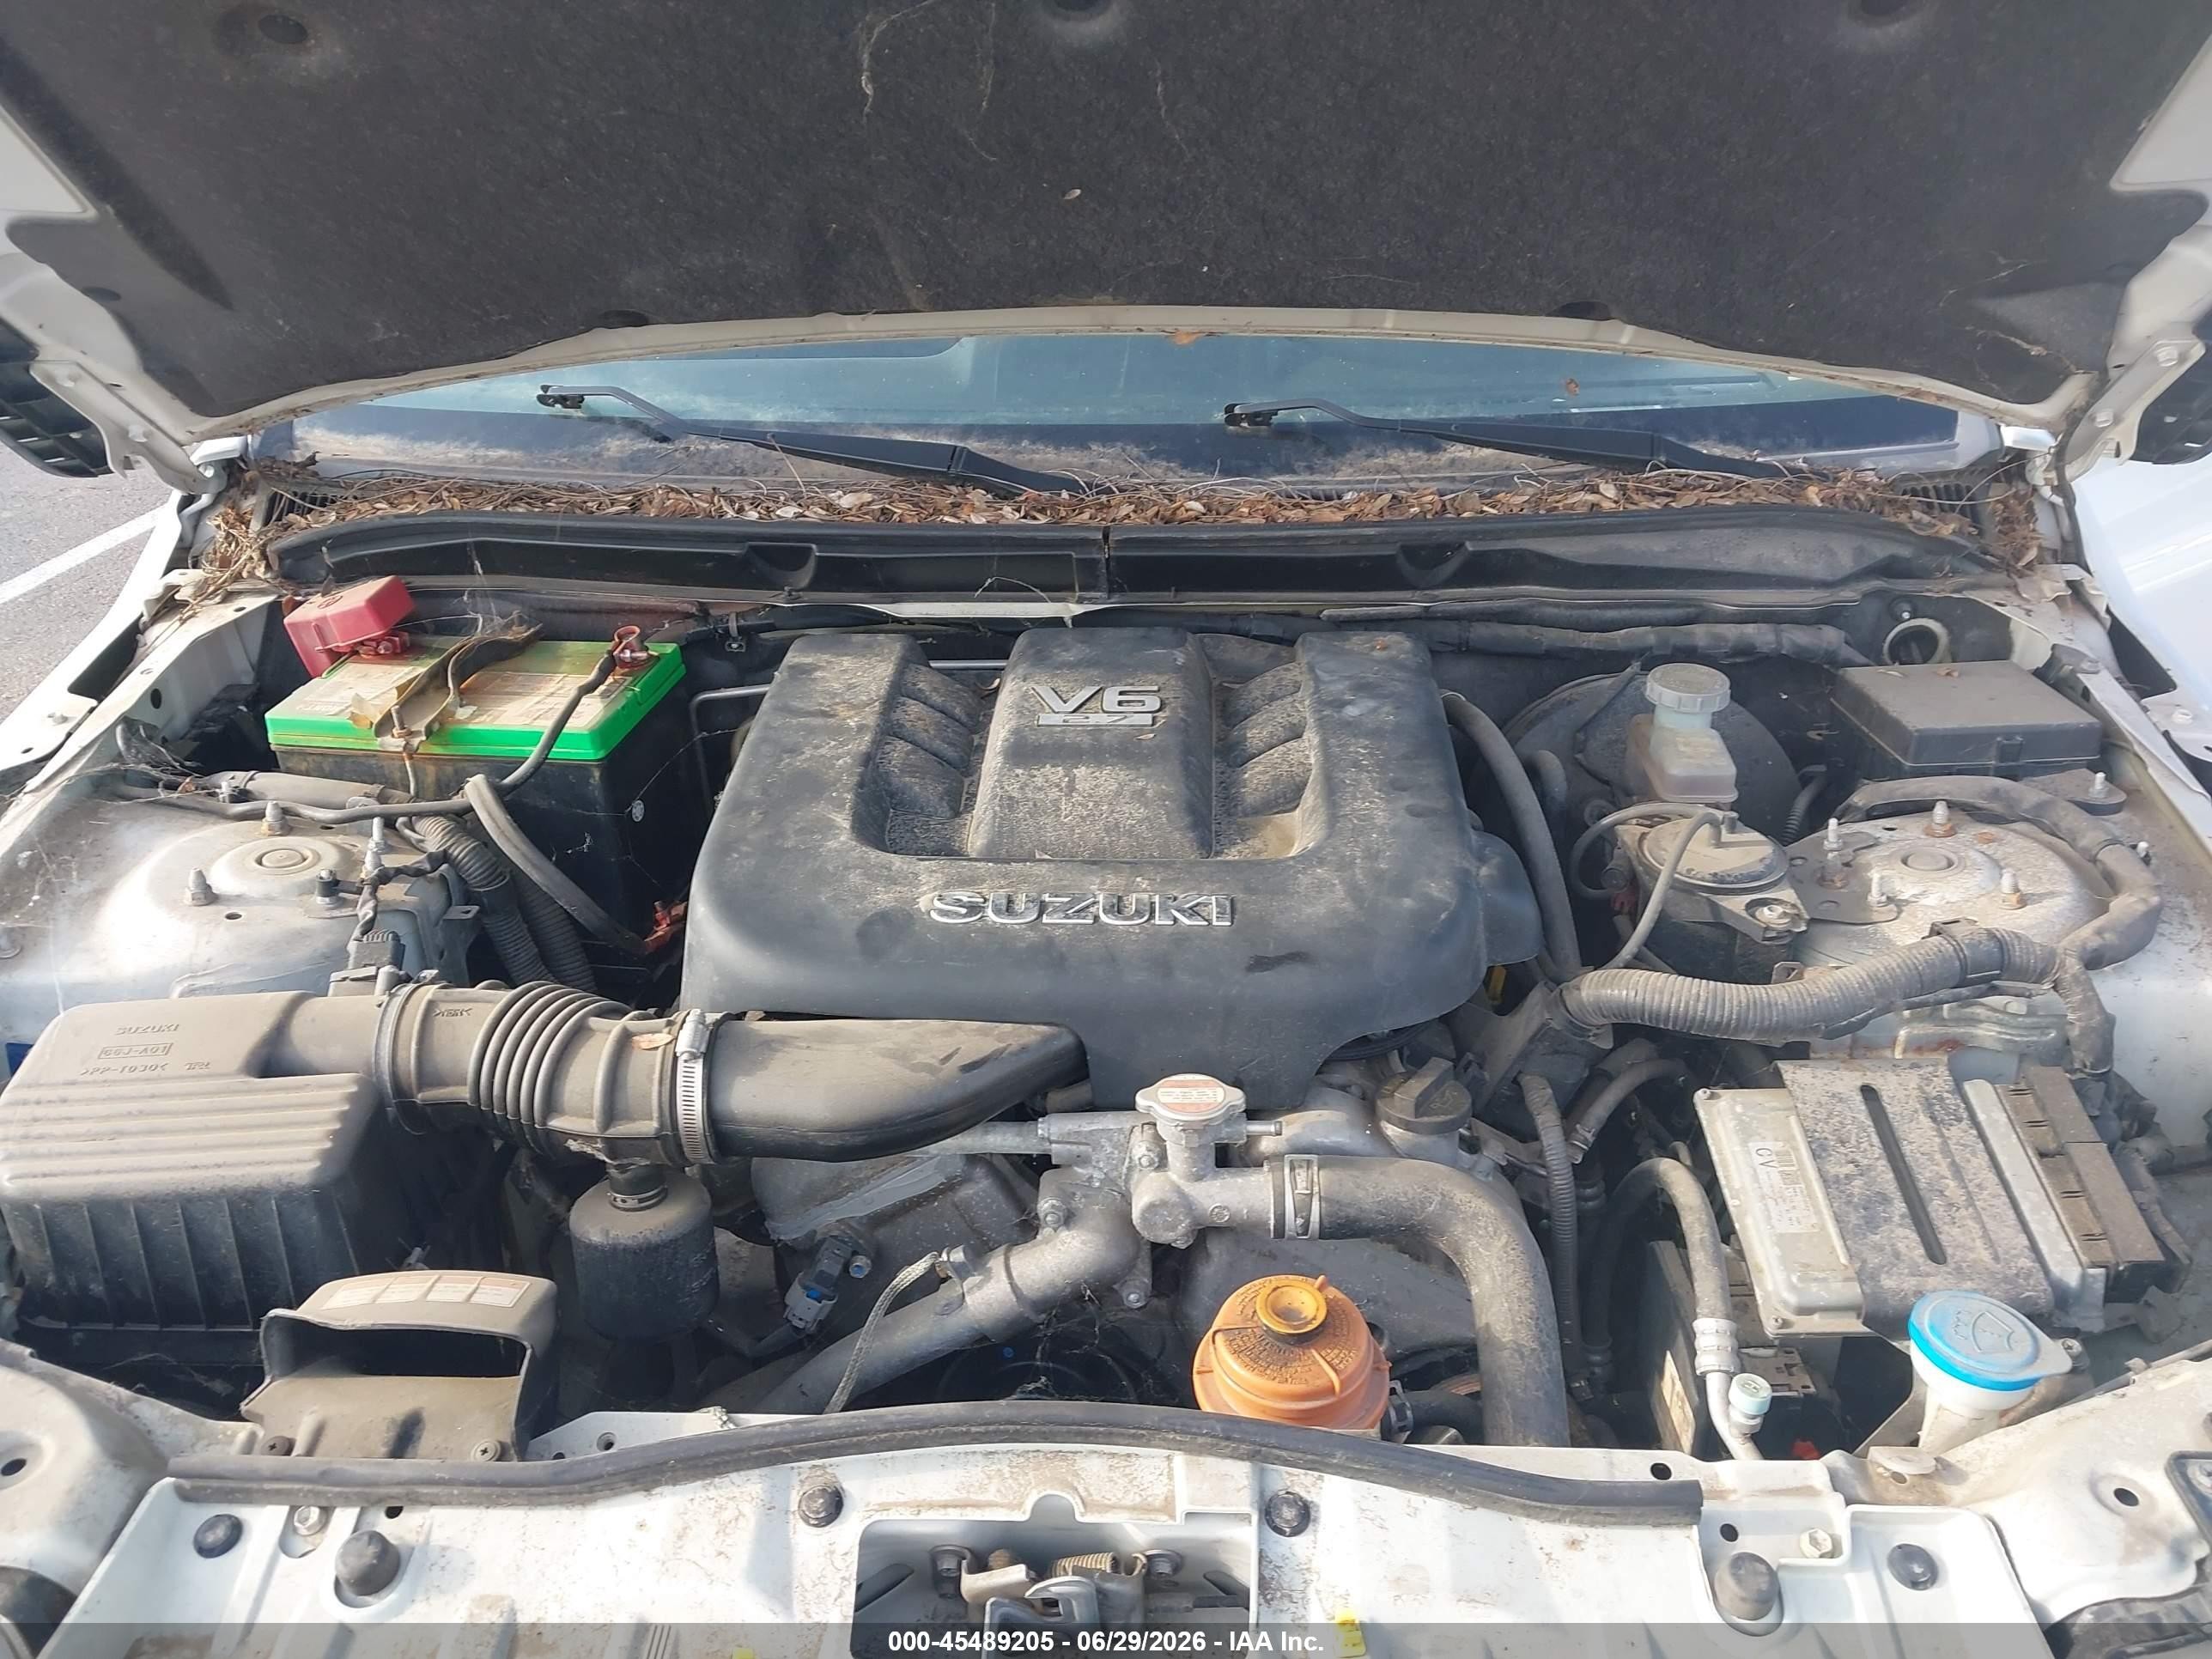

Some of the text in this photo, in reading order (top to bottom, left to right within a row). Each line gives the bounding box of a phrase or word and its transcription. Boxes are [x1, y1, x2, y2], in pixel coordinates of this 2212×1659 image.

[1030, 686, 1162, 714] V6
[1061, 714, 1133, 725] 2.7
[930, 890, 1234, 927] SUZUKI
[115, 1023, 179, 1036] SUZUKI
